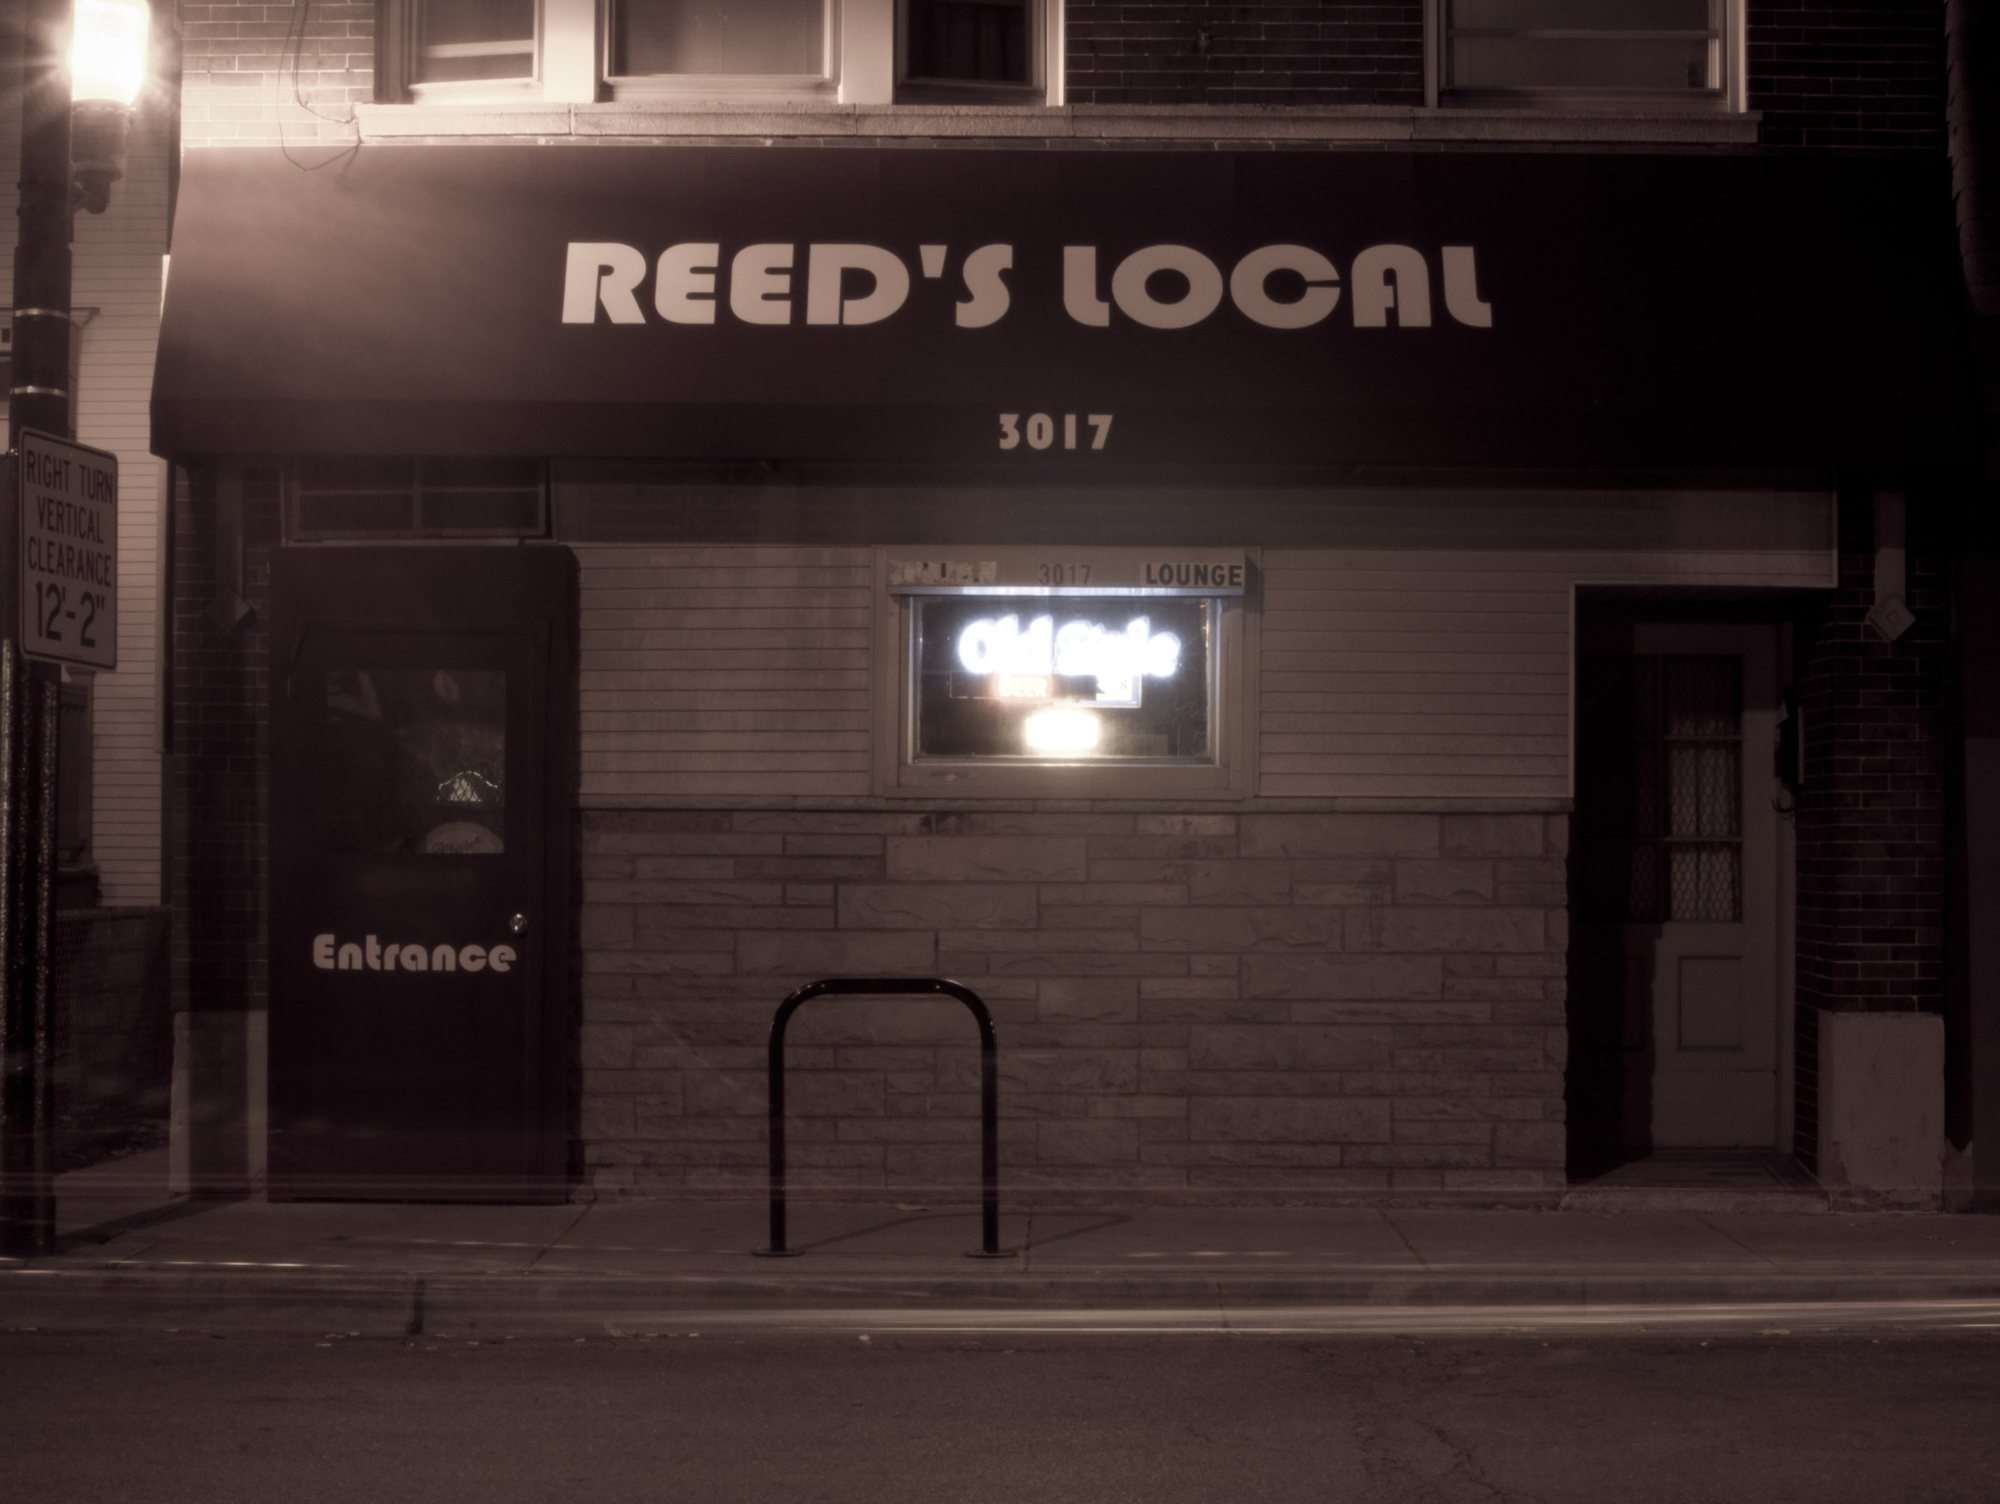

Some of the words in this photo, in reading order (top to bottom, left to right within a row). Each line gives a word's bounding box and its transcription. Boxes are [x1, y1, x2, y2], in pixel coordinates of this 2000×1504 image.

[561, 241, 1013, 328] REED'S
[1064, 243, 1493, 330] LOCAL
[1000, 413, 1114, 451] 3017
[27, 450, 71, 493] RIGHT
[80, 465, 113, 504] TURN
[37, 495, 104, 544] VERTICAL
[27, 536, 112, 587] CLEARANCE
[1038, 564, 1092, 585] 3017
[1146, 565, 1243, 585] LOUNGE
[958, 615, 1053, 675] Old
[312, 933, 517, 972] Entrance
